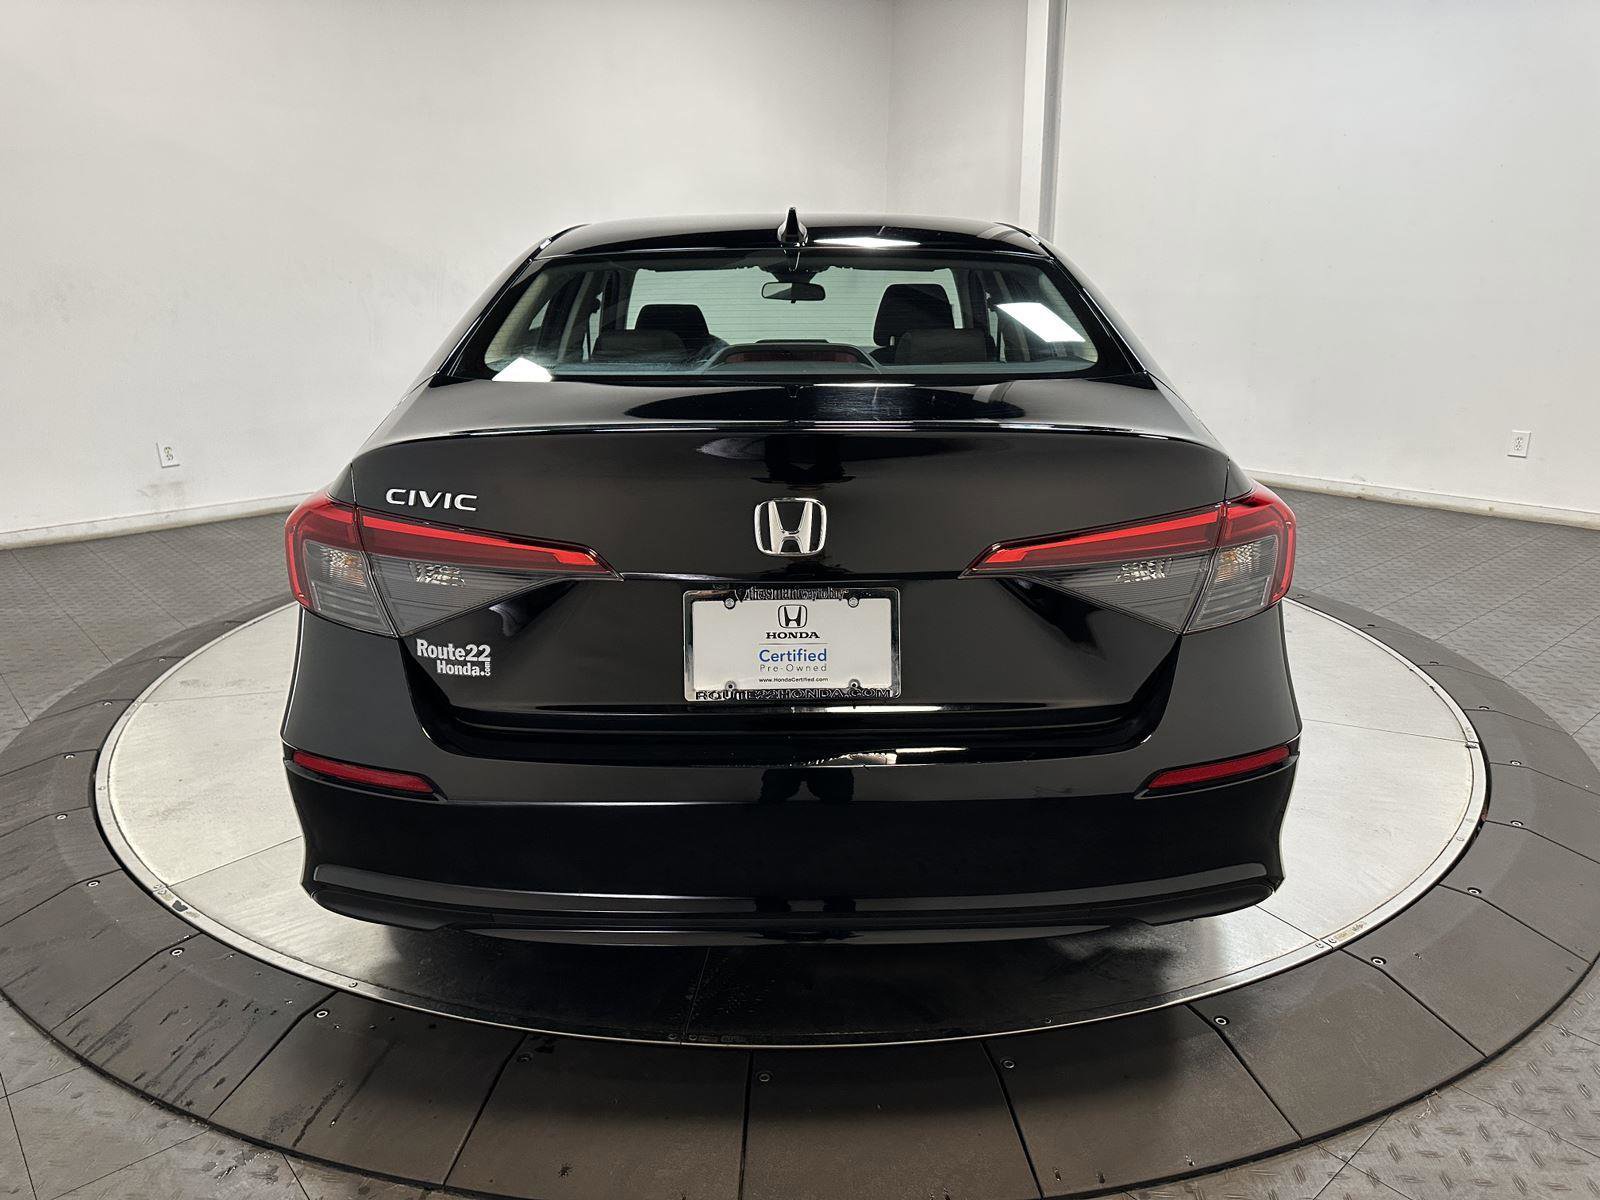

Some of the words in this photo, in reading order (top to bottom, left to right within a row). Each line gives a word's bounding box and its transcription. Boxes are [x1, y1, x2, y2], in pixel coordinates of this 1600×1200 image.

[385, 487, 479, 512] CIVIC
[765, 631, 821, 640] HONDA
[416, 638, 492, 662] Route22
[758, 648, 827, 662] Certified
[759, 663, 828, 673] Pre-Owned
